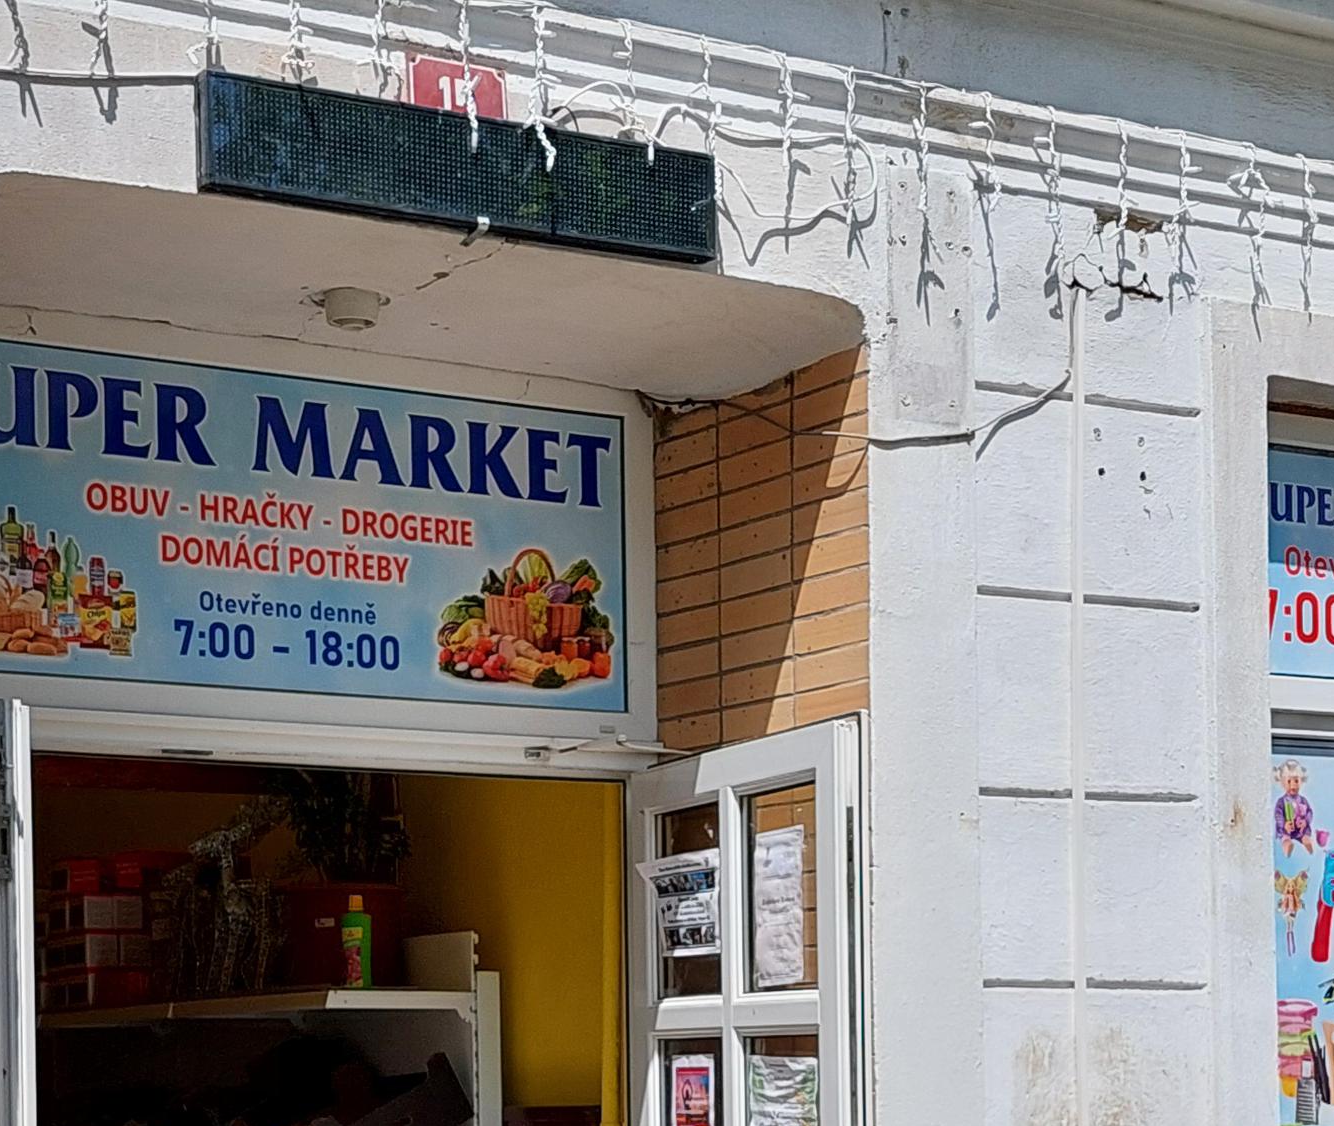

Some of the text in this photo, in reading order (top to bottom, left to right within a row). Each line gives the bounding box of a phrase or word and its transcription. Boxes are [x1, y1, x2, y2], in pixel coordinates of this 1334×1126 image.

[252, 395, 611, 508] MARKET
[86, 482, 170, 517] OBUV
[200, 491, 313, 531] HRAČKY
[342, 508, 473, 546] DROGERIE
[161, 534, 409, 584] DOMÁCÍ POTŘEBY
[200, 590, 376, 626] Otevřeno denně
[174, 619, 254, 660] 7:00
[305, 629, 400, 671] 18:00
